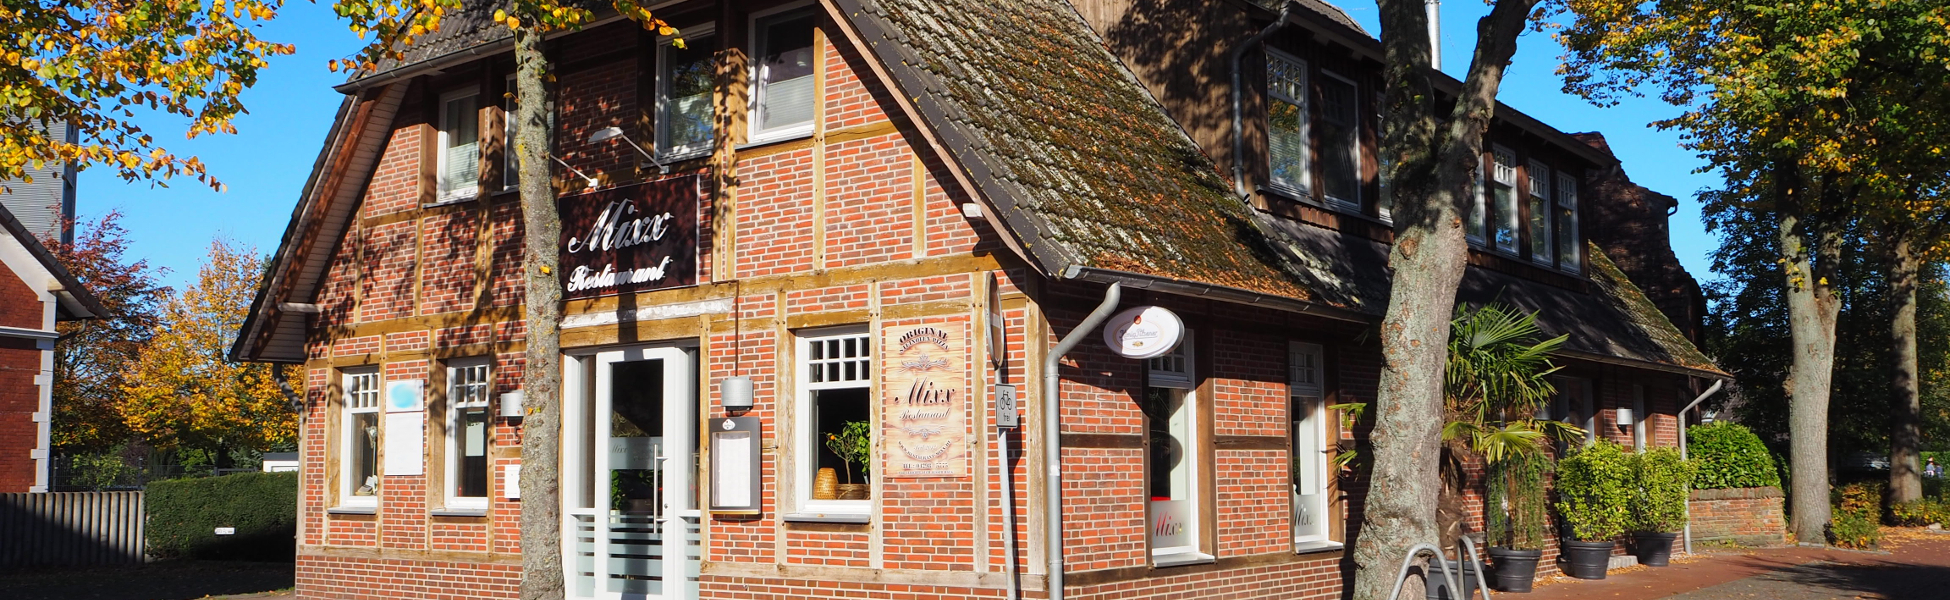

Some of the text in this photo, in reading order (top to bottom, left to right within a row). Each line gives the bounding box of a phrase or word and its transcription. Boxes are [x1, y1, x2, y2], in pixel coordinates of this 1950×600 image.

[568, 198, 671, 253] Mixx
[567, 256, 671, 292] Restaurant
[899, 327, 948, 344] ORIGINAL
[895, 377, 955, 405] Mixx
[899, 408, 951, 419] Restaurant
[1003, 412, 1011, 422] frei
